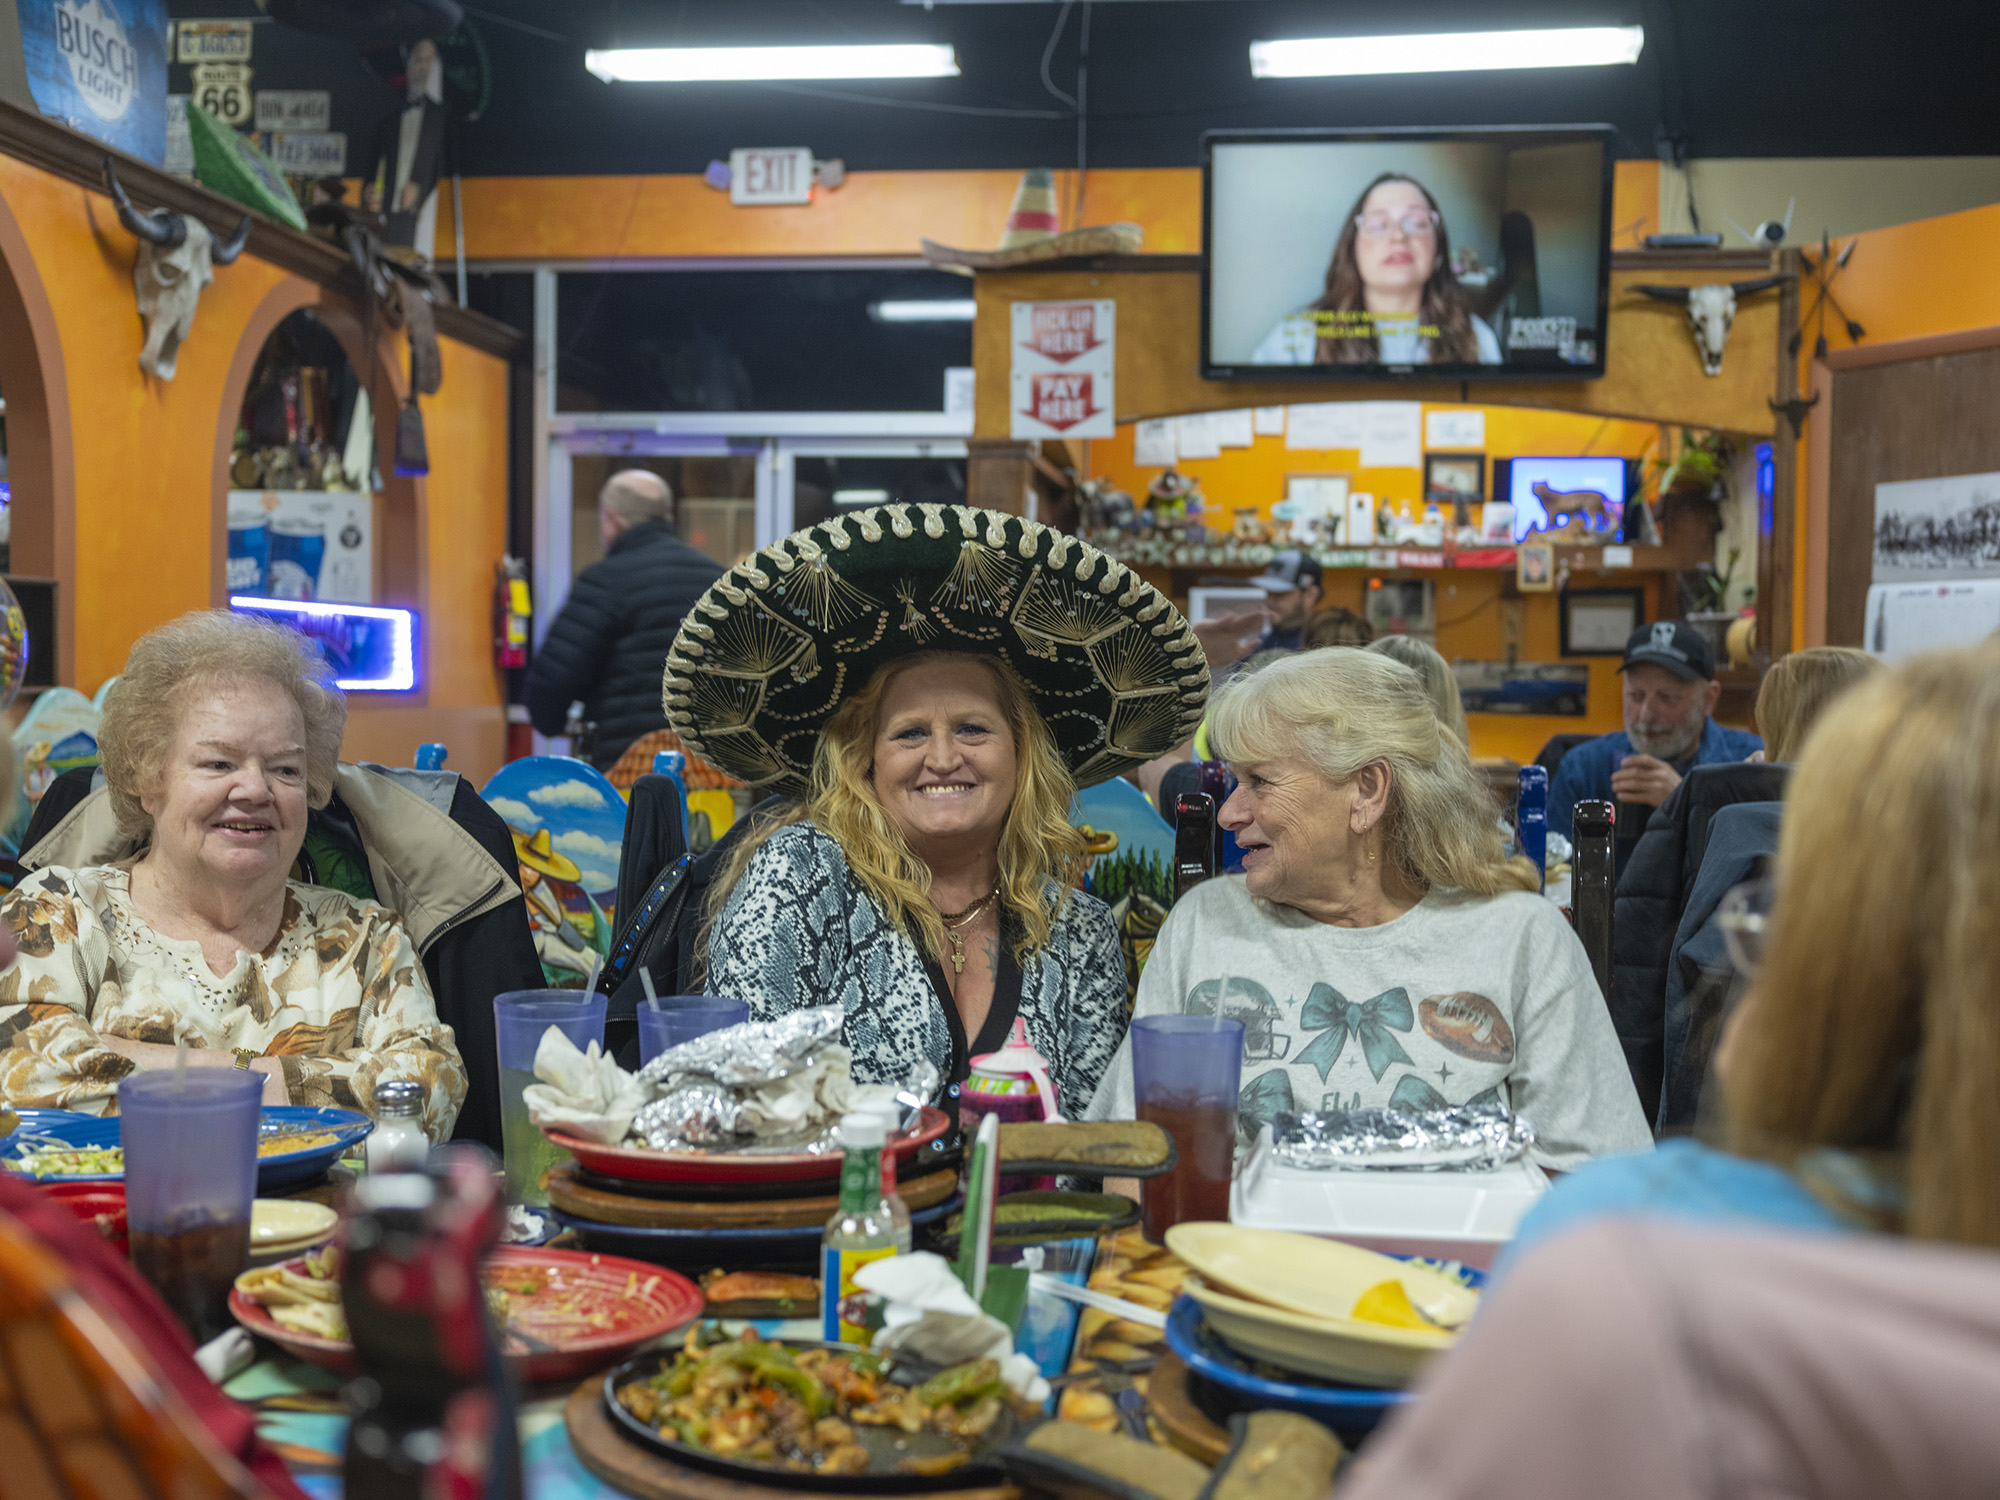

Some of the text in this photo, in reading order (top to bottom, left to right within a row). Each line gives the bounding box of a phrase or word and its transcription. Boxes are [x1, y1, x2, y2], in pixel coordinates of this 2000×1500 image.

[57, 8, 137, 88] BUSCH
[78, 64, 123, 103] LIGHT
[203, 85, 241, 118] 66
[745, 153, 797, 195] EXIT
[1041, 331, 1086, 353] HERE
[1040, 377, 1083, 400] PAY
[1038, 399, 1085, 421] HERE
